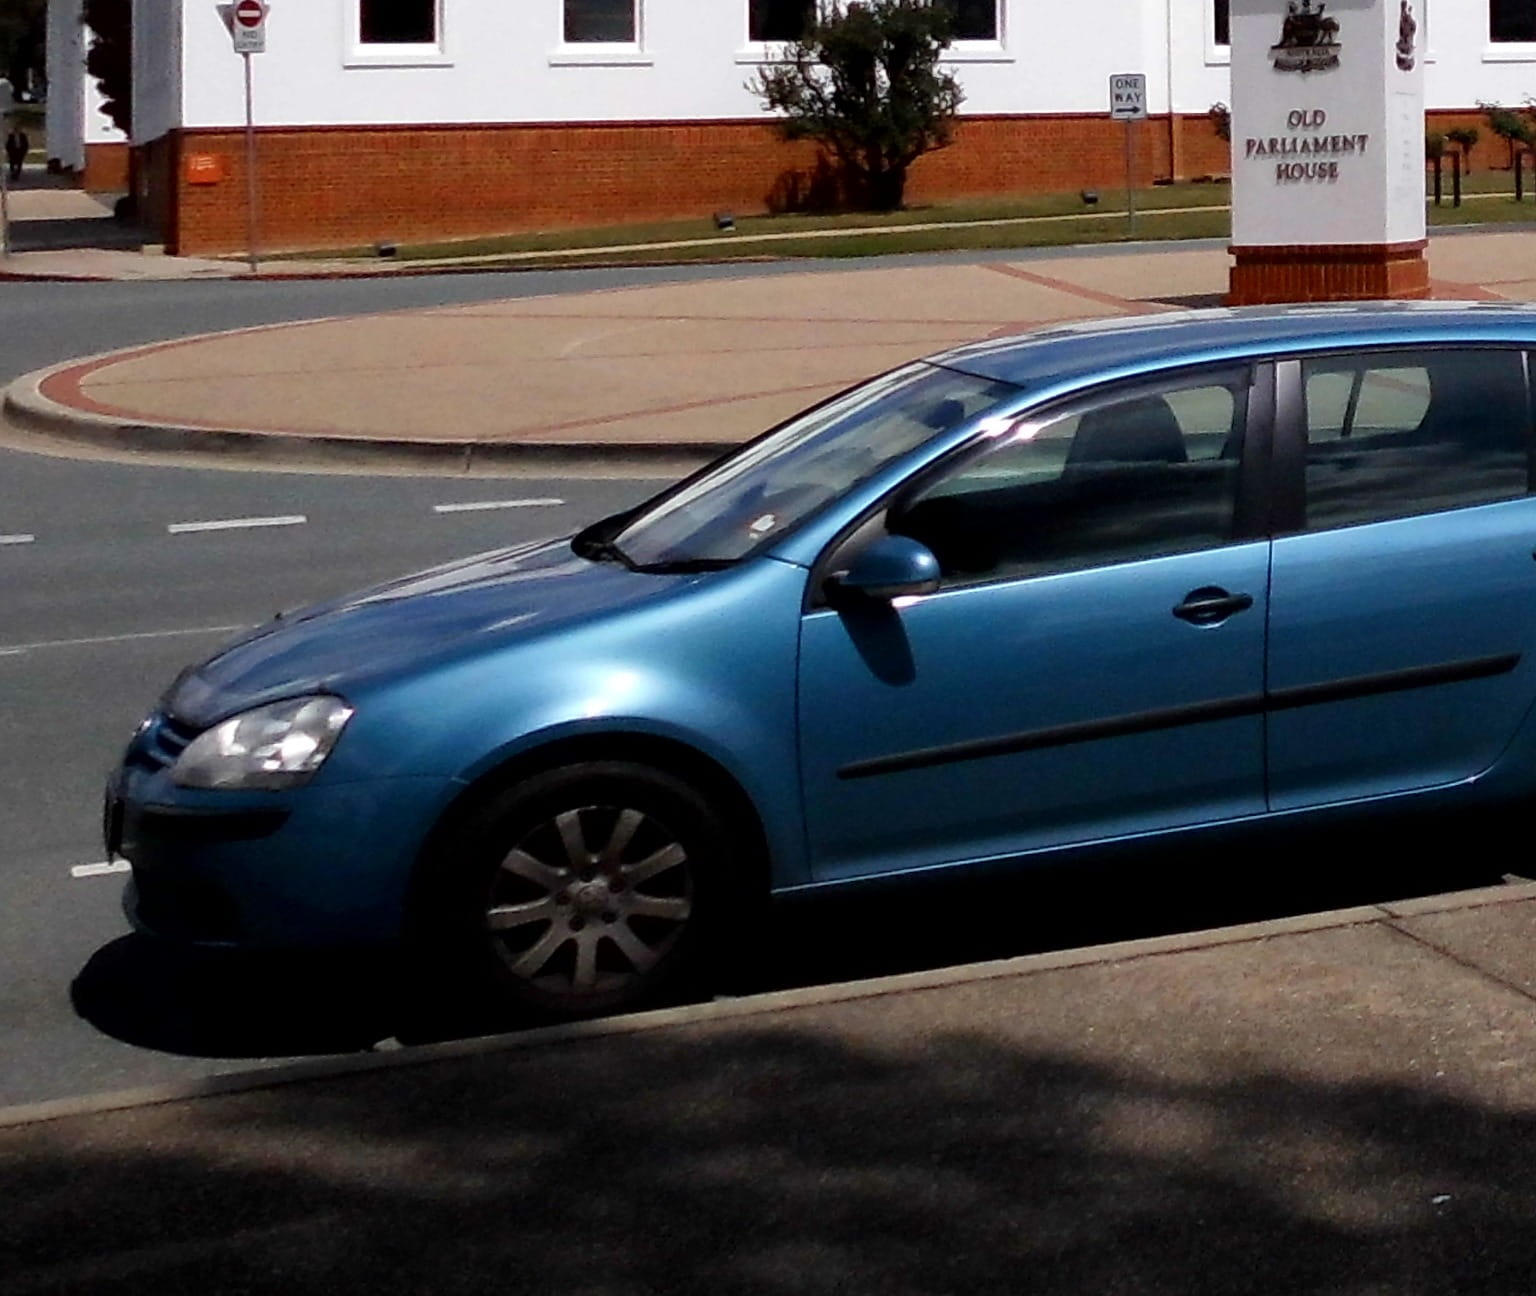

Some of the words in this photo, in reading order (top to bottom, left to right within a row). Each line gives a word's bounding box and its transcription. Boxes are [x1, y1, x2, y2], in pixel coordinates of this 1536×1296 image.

[1115, 78, 1140, 90] ONE
[1114, 92, 1142, 103] WAY
[1288, 109, 1326, 127] OLD
[1246, 134, 1369, 156] PARLIAMENT
[1276, 161, 1339, 180] HOUSE
